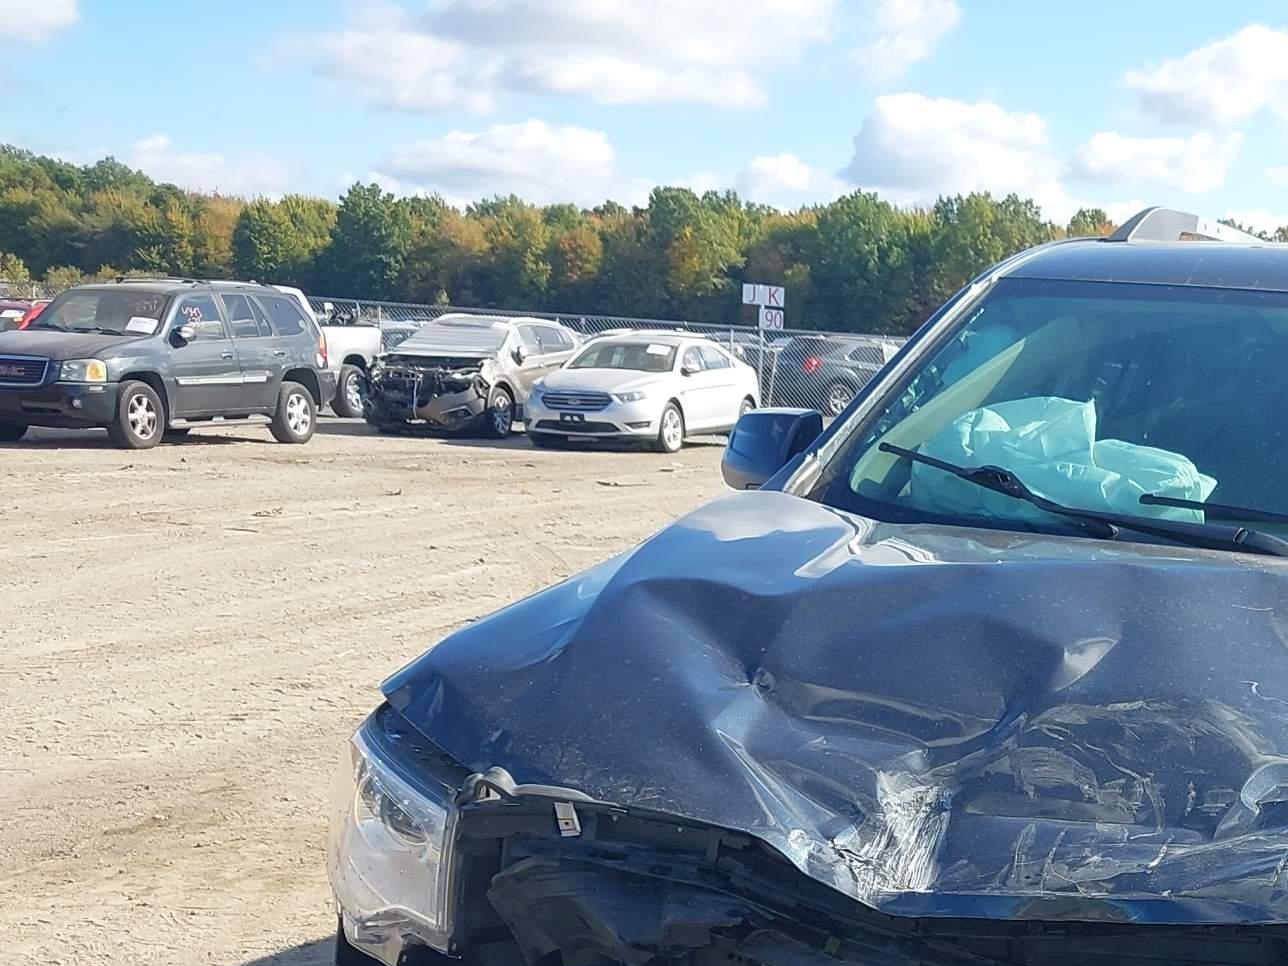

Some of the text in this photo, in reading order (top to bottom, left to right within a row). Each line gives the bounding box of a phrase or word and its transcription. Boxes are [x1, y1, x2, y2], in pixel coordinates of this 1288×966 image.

[748, 285, 780, 306] J K
[764, 310, 783, 330] 90
